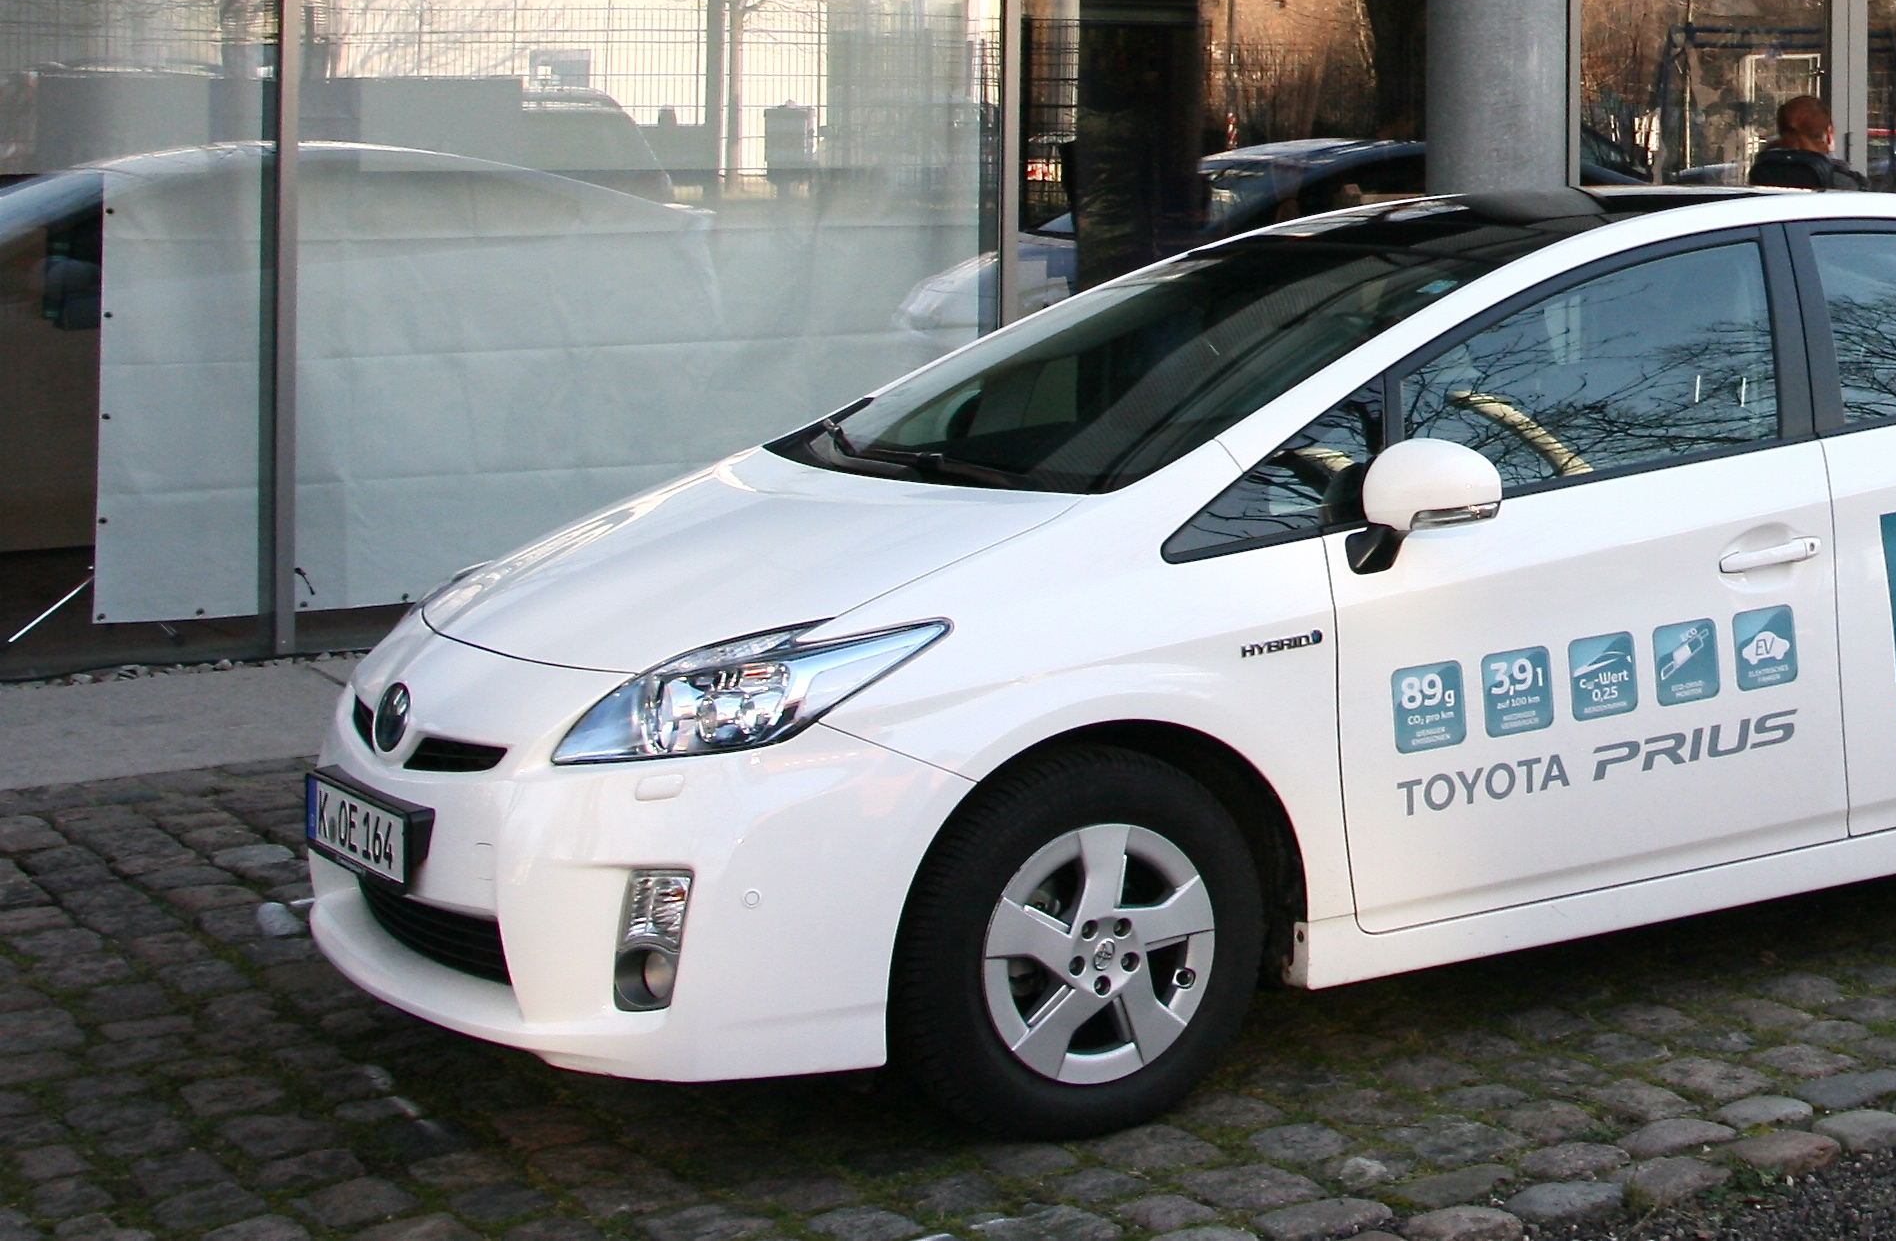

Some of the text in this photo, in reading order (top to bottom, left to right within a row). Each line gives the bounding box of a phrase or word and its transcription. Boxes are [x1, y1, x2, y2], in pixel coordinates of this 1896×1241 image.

[1240, 634, 1311, 658] HYBRID
[1755, 637, 1775, 656] EV
[1511, 697, 1527, 707] 100
[1592, 686, 1619, 702] 0,25
[1425, 713, 1440, 724] pro
[1440, 711, 1455, 719] km
[1396, 708, 1798, 816] TOYOTA PRIUS
[318, 788, 329, 839] K
[338, 799, 358, 854] OE
[362, 811, 394, 870] 164
